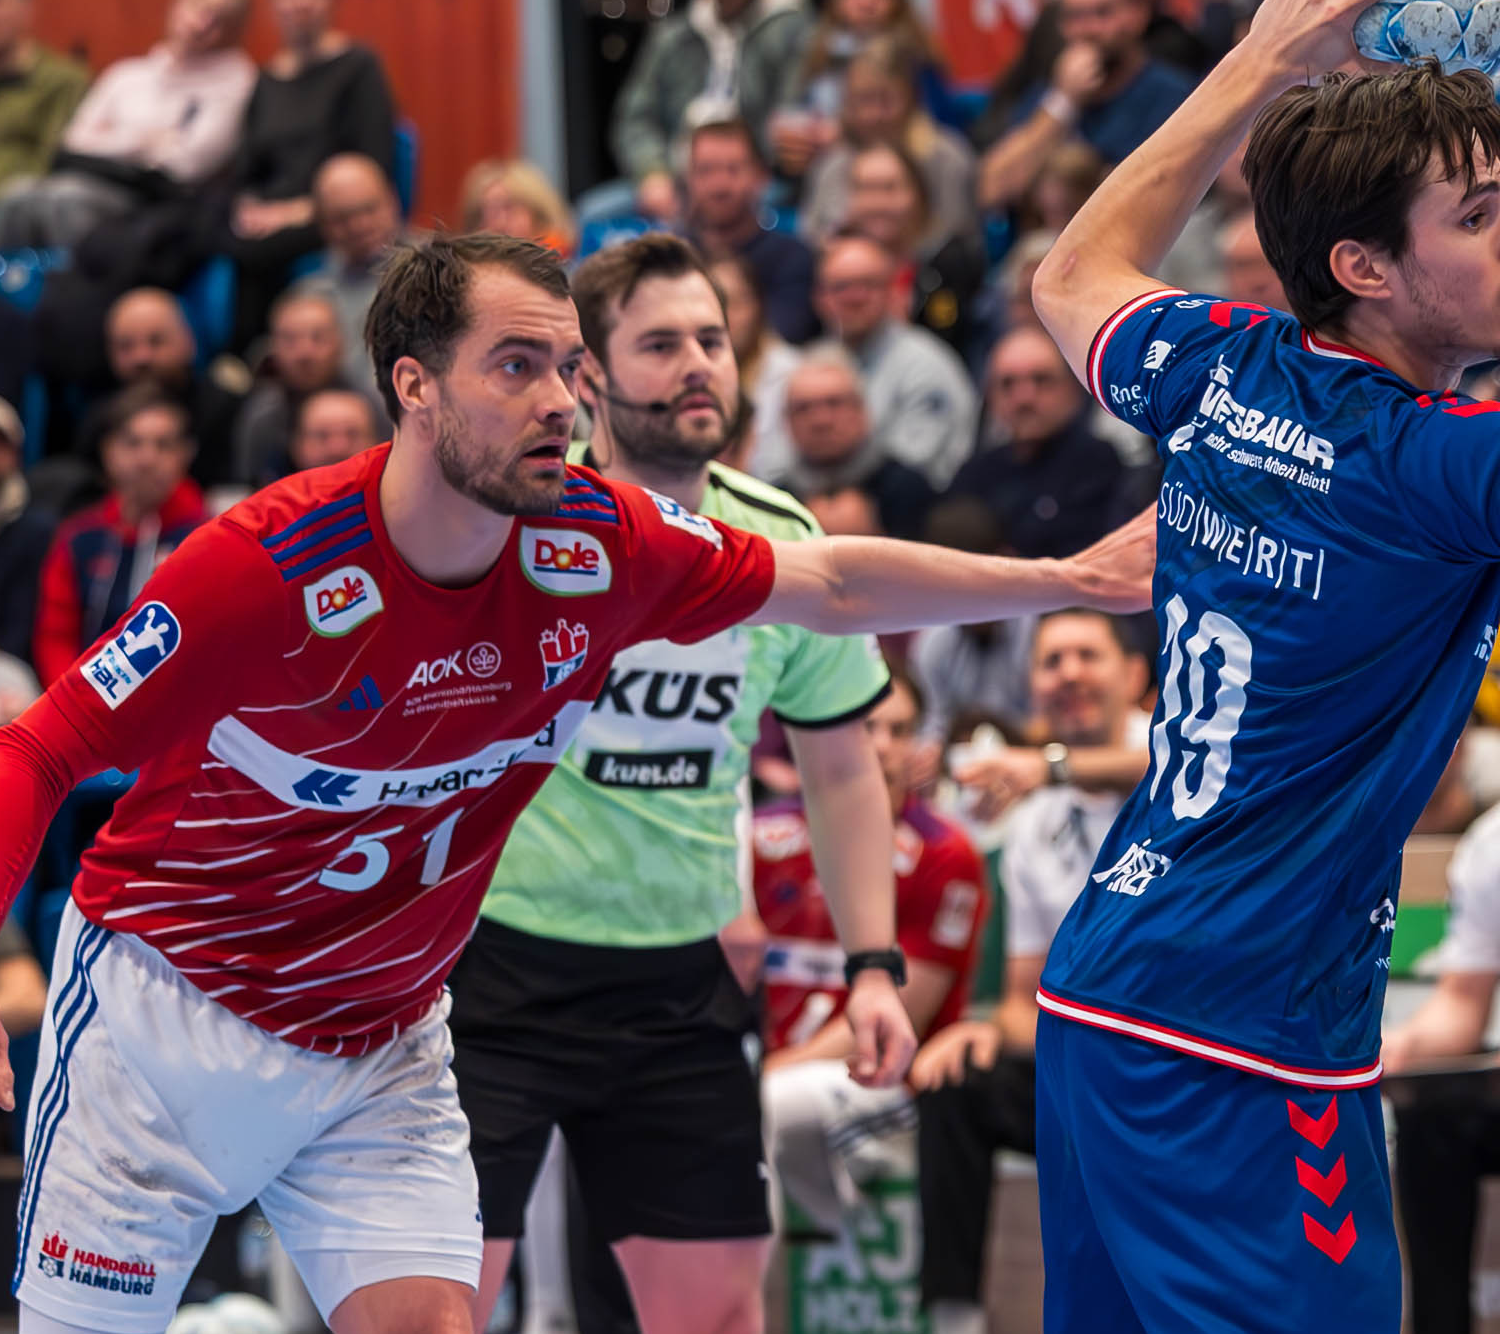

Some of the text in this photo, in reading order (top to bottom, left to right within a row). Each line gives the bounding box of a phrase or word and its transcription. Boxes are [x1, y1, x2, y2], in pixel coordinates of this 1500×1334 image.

[534, 539, 600, 570] Dole
[316, 577, 364, 616] Dole
[406, 650, 464, 689] AOK
[590, 668, 741, 724] KÜS
[316, 808, 466, 893] 51
[69, 1265, 156, 1296] HAMBURG
[73, 1248, 156, 1277] HANDBALL
